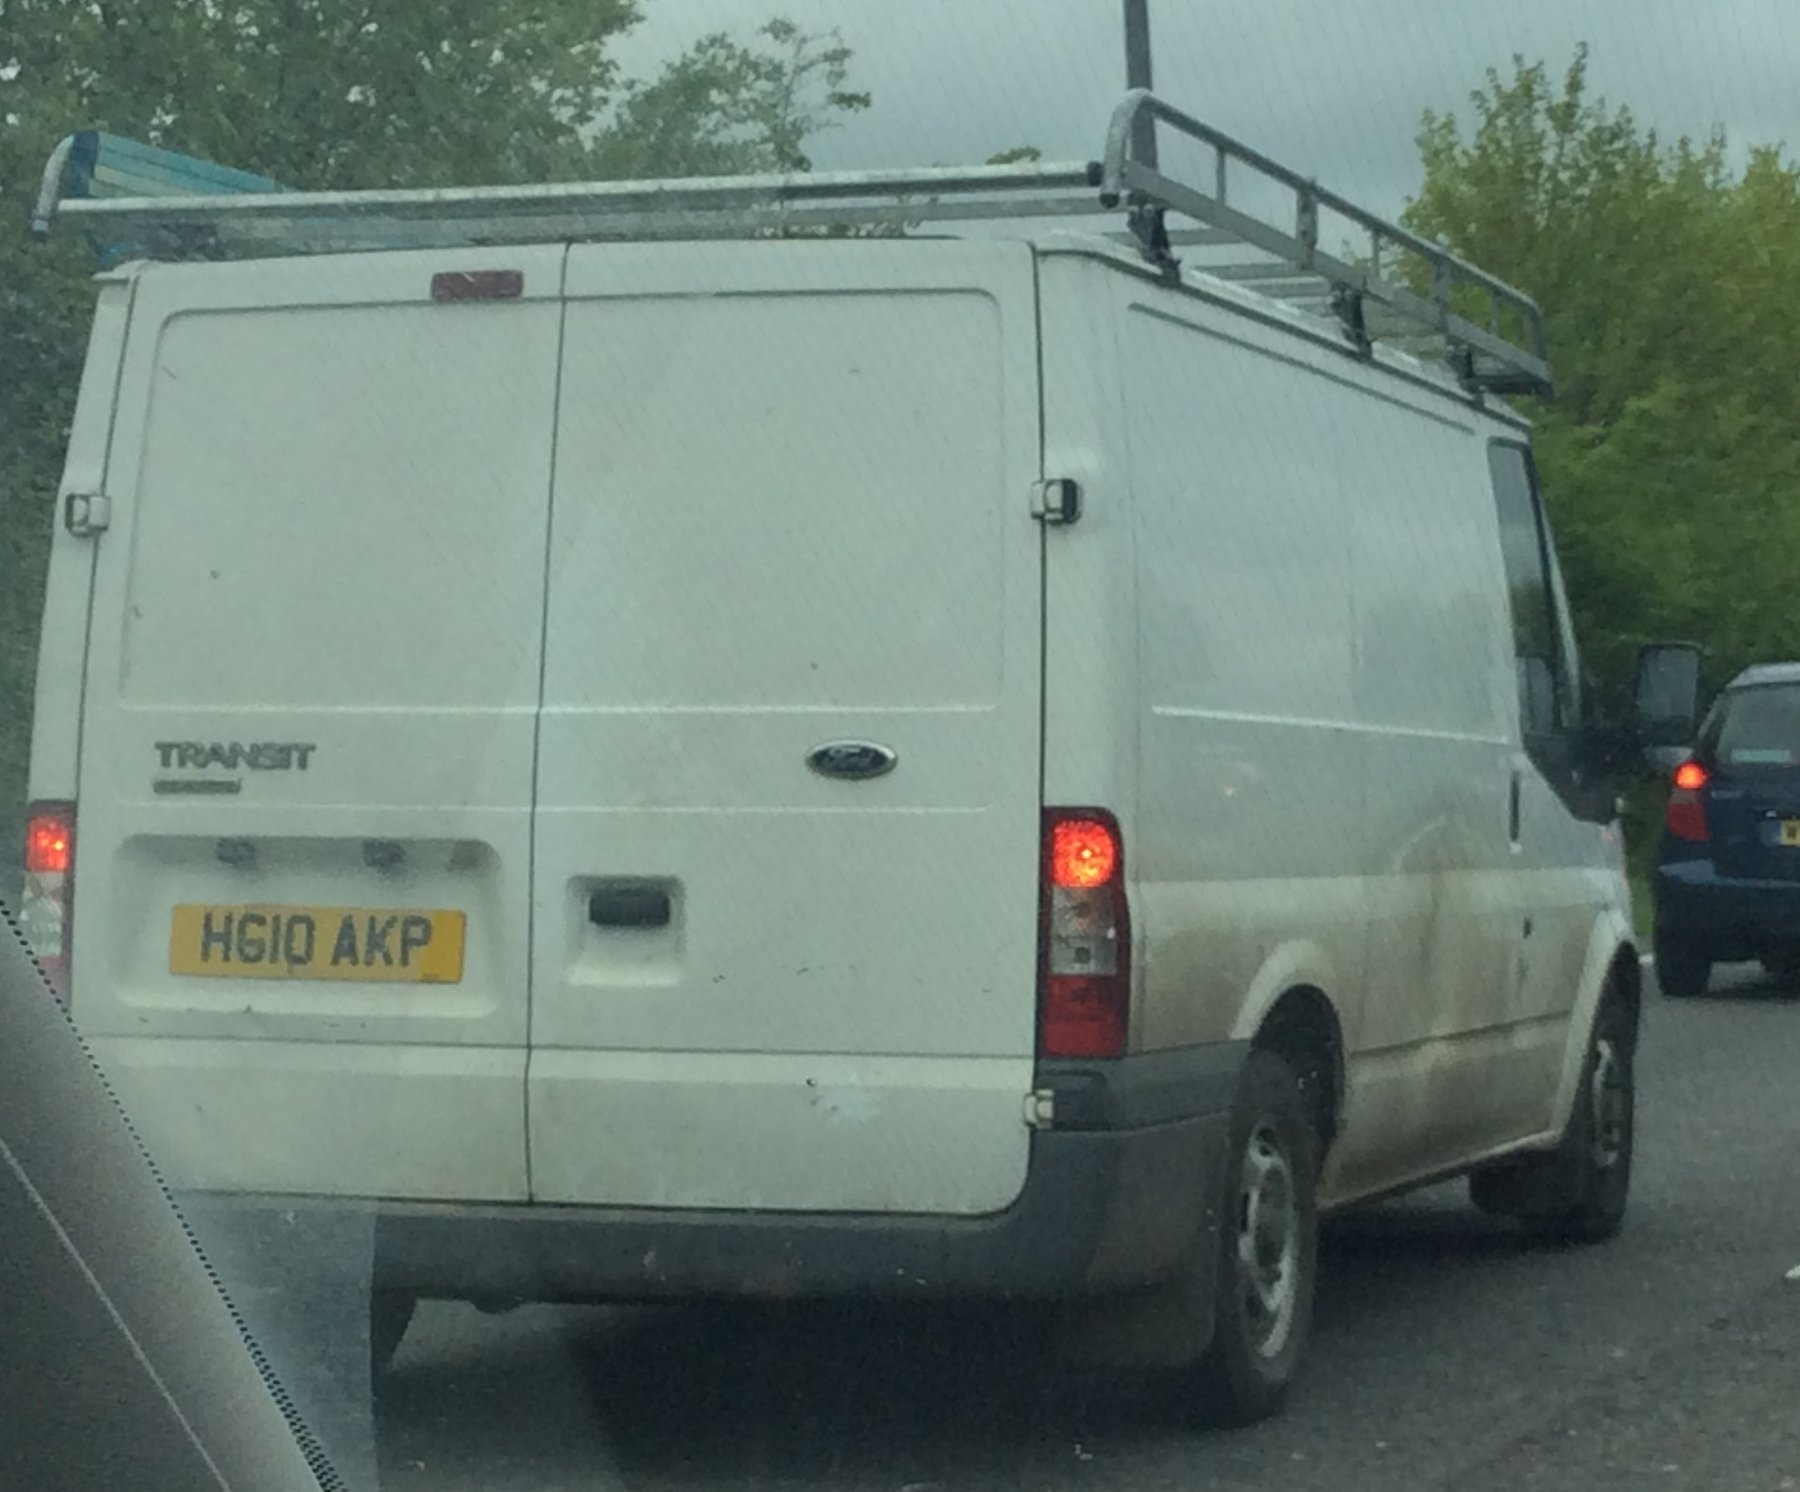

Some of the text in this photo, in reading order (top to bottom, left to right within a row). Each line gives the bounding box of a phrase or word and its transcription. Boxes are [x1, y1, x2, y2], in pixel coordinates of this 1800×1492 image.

[154, 741, 317, 770] TRANSIT
[200, 911, 432, 967] HG10 AKP
